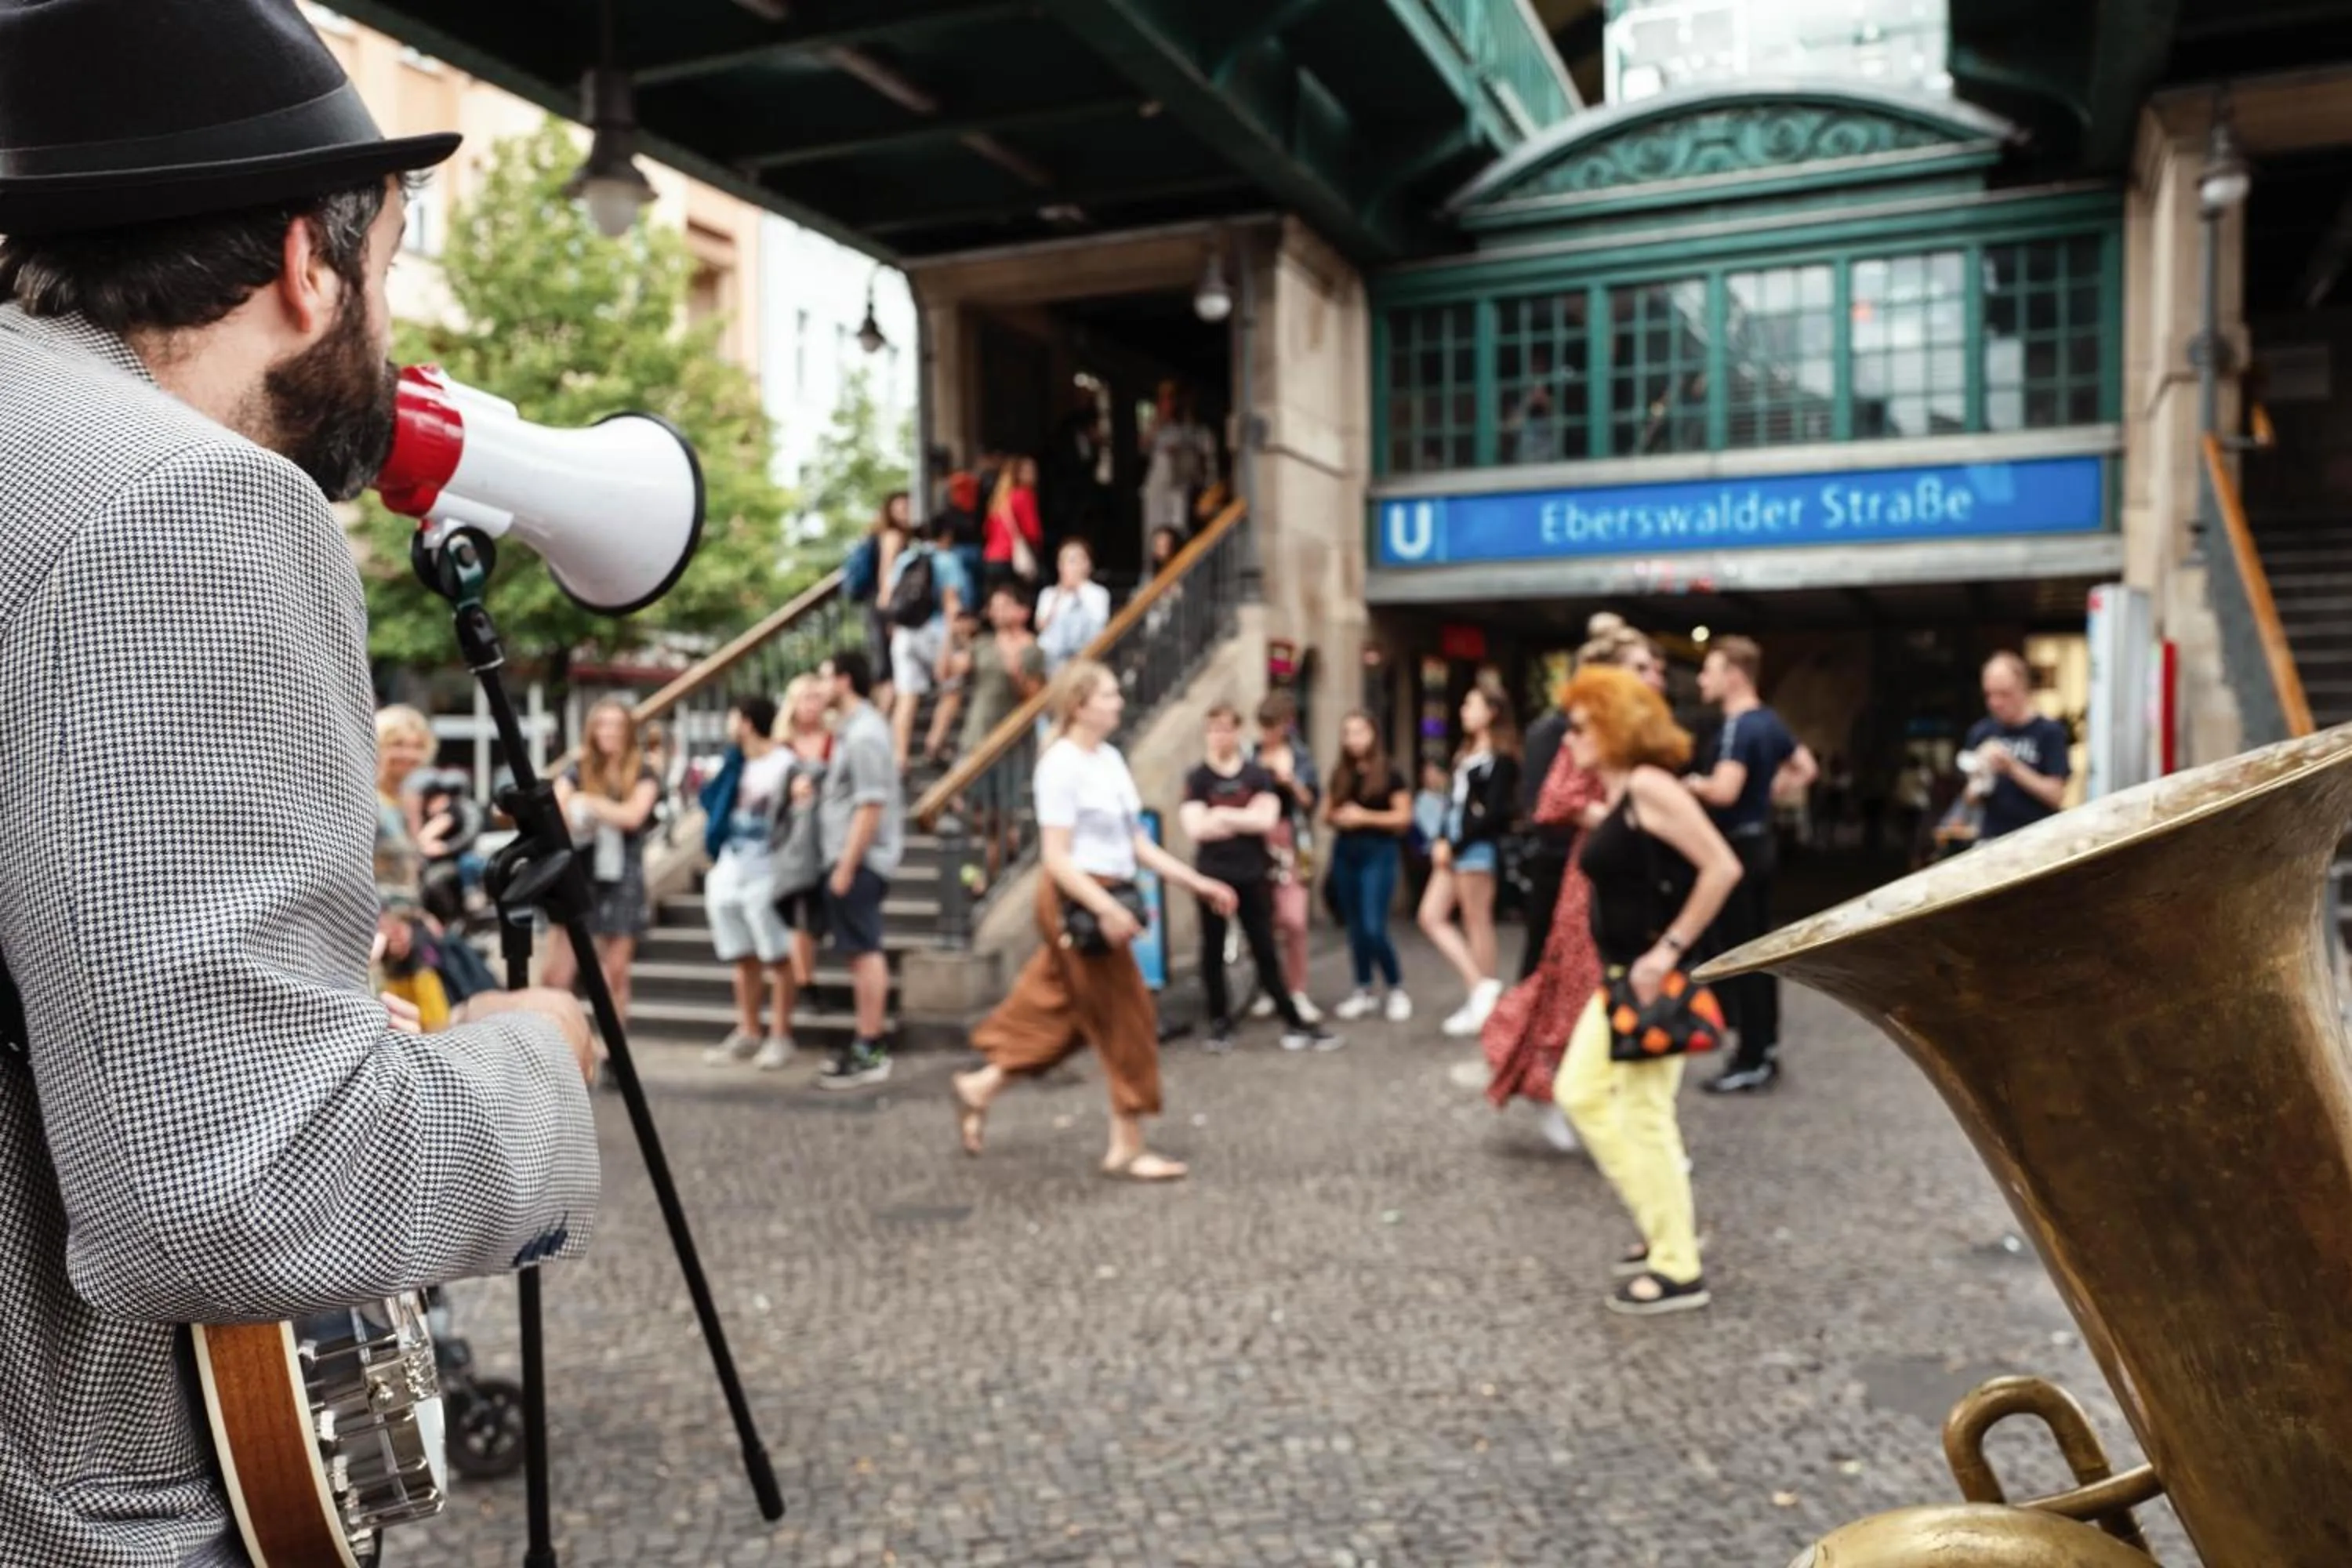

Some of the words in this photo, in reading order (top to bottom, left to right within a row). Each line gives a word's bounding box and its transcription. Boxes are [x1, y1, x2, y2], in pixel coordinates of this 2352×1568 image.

[1389, 501, 1433, 559] U
[1541, 485, 1802, 543] Eberswalder
[1821, 474, 1972, 529] Straße
